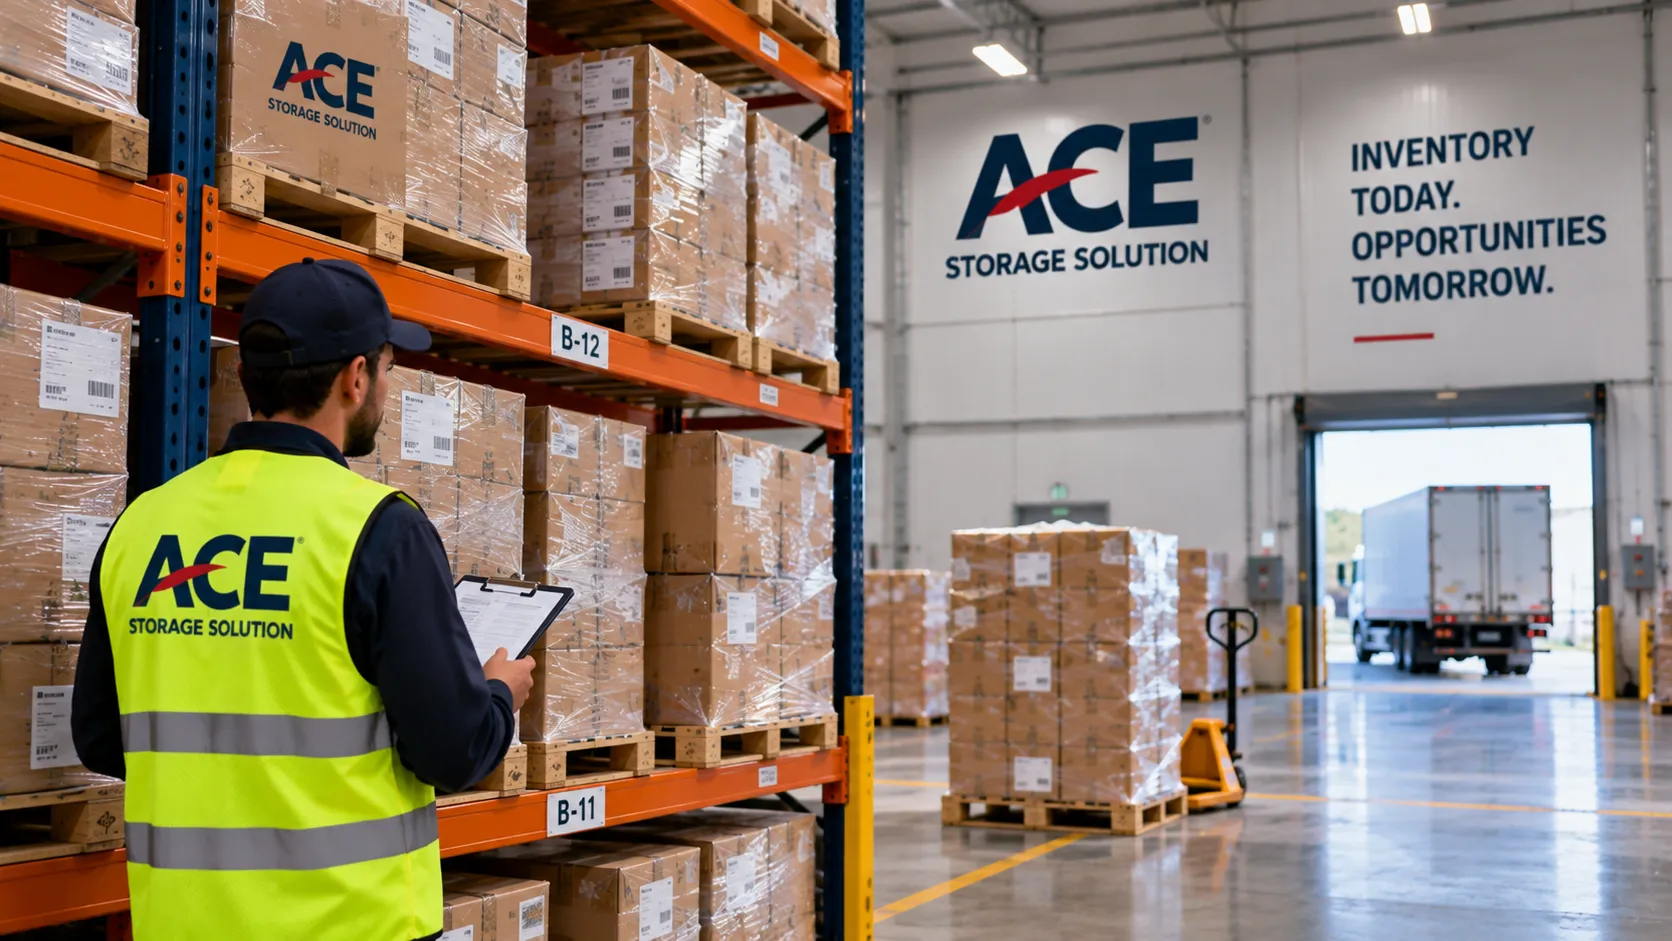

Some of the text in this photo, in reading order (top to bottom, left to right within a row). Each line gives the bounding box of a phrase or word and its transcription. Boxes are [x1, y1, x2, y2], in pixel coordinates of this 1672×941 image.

[272, 41, 375, 119] ACE
[268, 97, 377, 140] STORAGE SOLUTION
[1353, 126, 1535, 171] INVENTORY
[956, 116, 1198, 240] ACE
[1352, 180, 1460, 216] TODAY.
[1352, 214, 1606, 260] OPPORTUNITIES
[945, 240, 1209, 279] STORAGE SOLUTION
[1352, 264, 1555, 304] TOMORROW.
[561, 325, 600, 358] B-12
[132, 534, 295, 611] ACE
[129, 618, 293, 640] STORAGE SOLUTION
[558, 796, 595, 826] B-11
